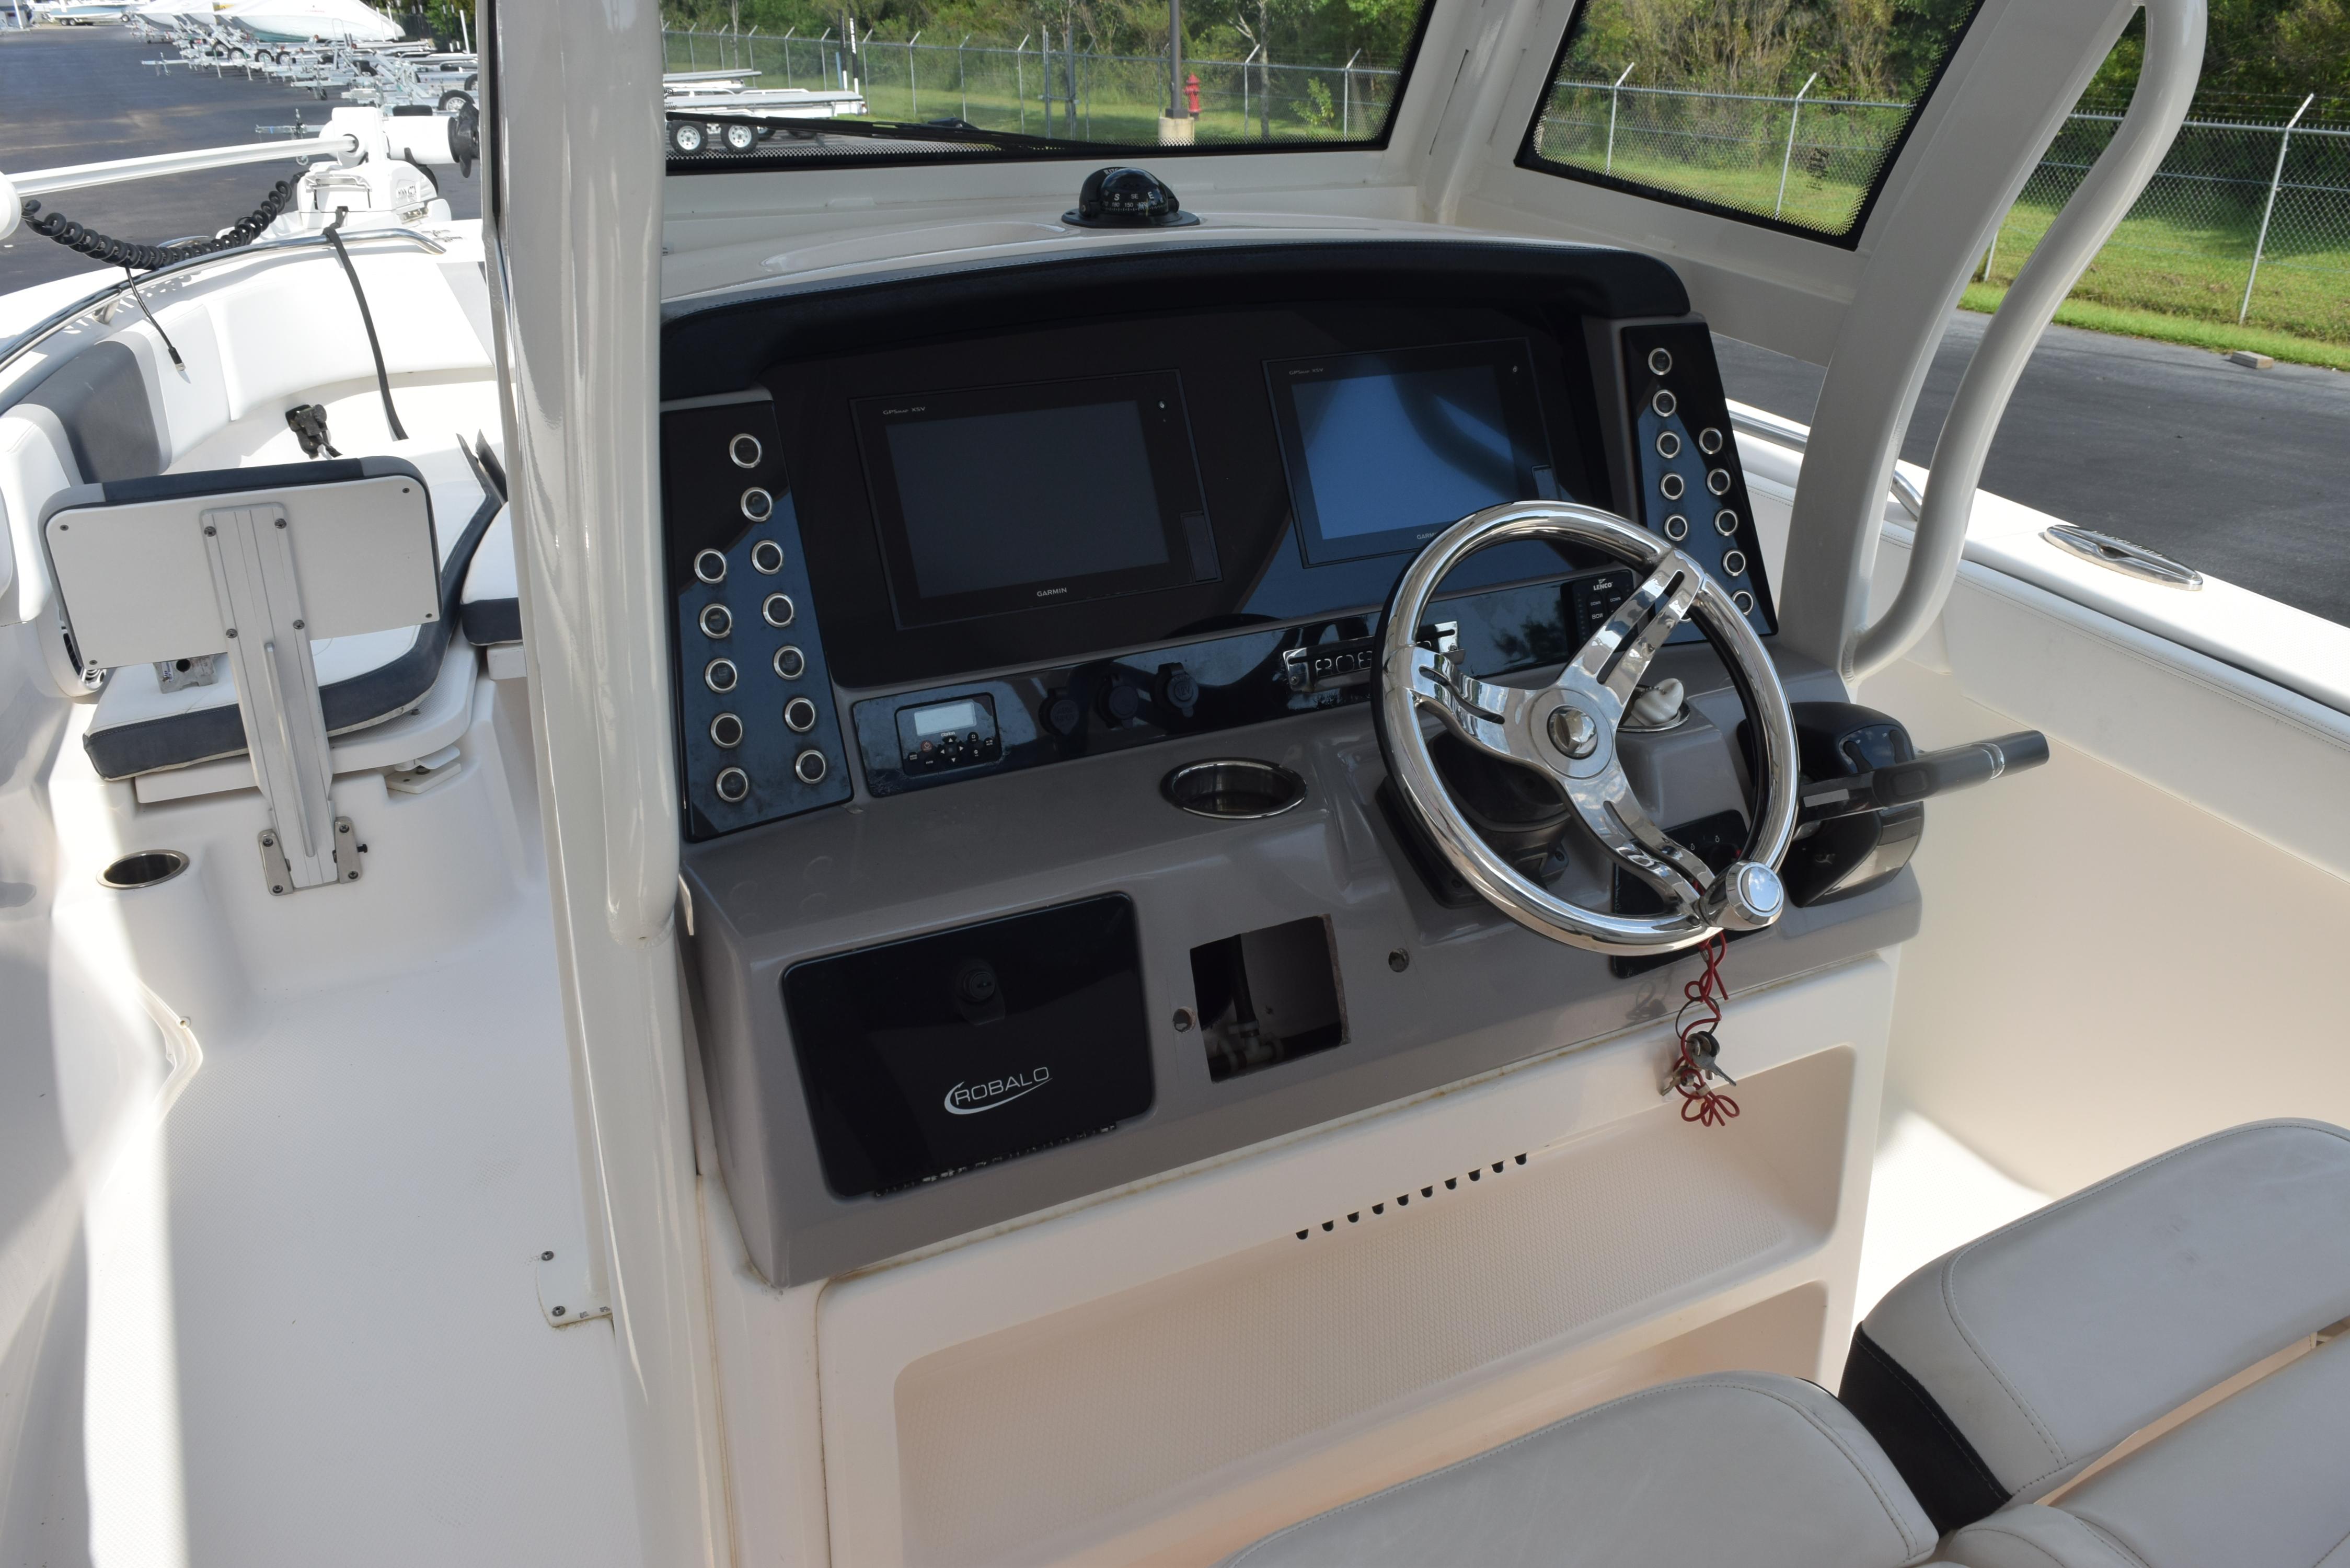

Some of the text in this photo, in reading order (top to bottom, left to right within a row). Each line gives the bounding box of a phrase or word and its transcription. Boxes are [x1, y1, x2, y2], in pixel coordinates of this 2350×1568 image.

[1417, 531, 1438, 539] GARM
[1593, 582, 1612, 591] LENCO
[1036, 587, 1067, 597] GARMIN
[954, 1067, 1050, 1105] ROBALO
